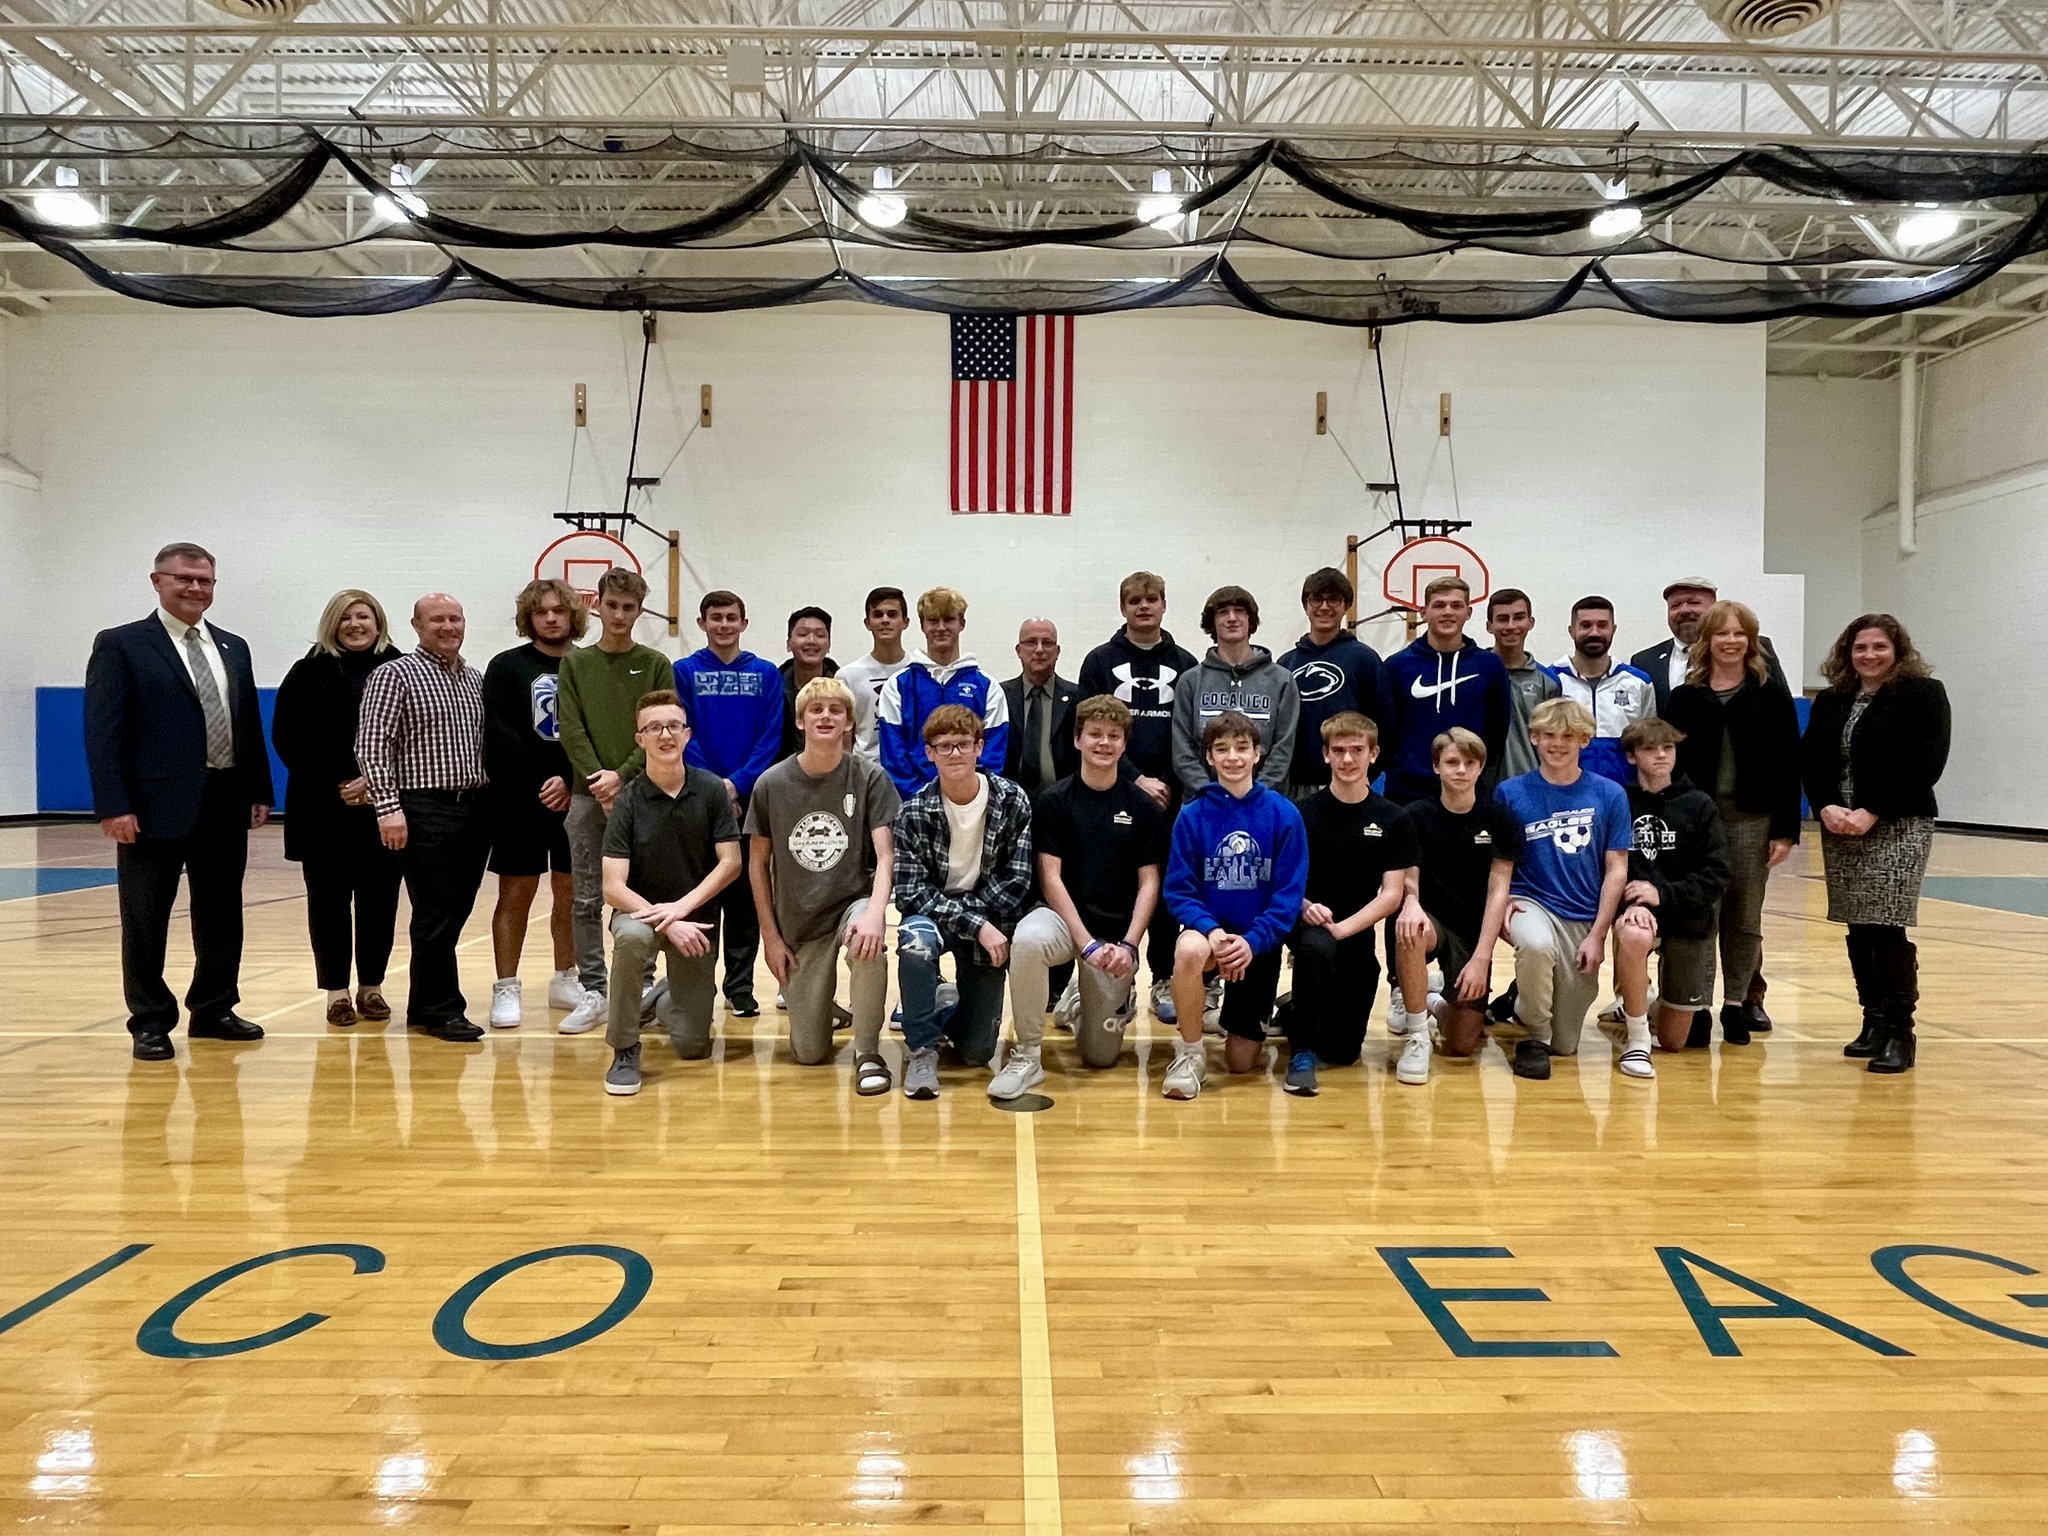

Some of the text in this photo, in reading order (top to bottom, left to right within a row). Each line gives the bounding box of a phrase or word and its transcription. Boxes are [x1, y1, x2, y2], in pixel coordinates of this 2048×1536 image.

[694, 671, 763, 685] UNDER
[1201, 692, 1272, 710] COCALICO
[1524, 816, 1593, 835] EAGLES
[1203, 866, 1271, 881] EAGLES
[1376, 1245, 2048, 1358] EAG
